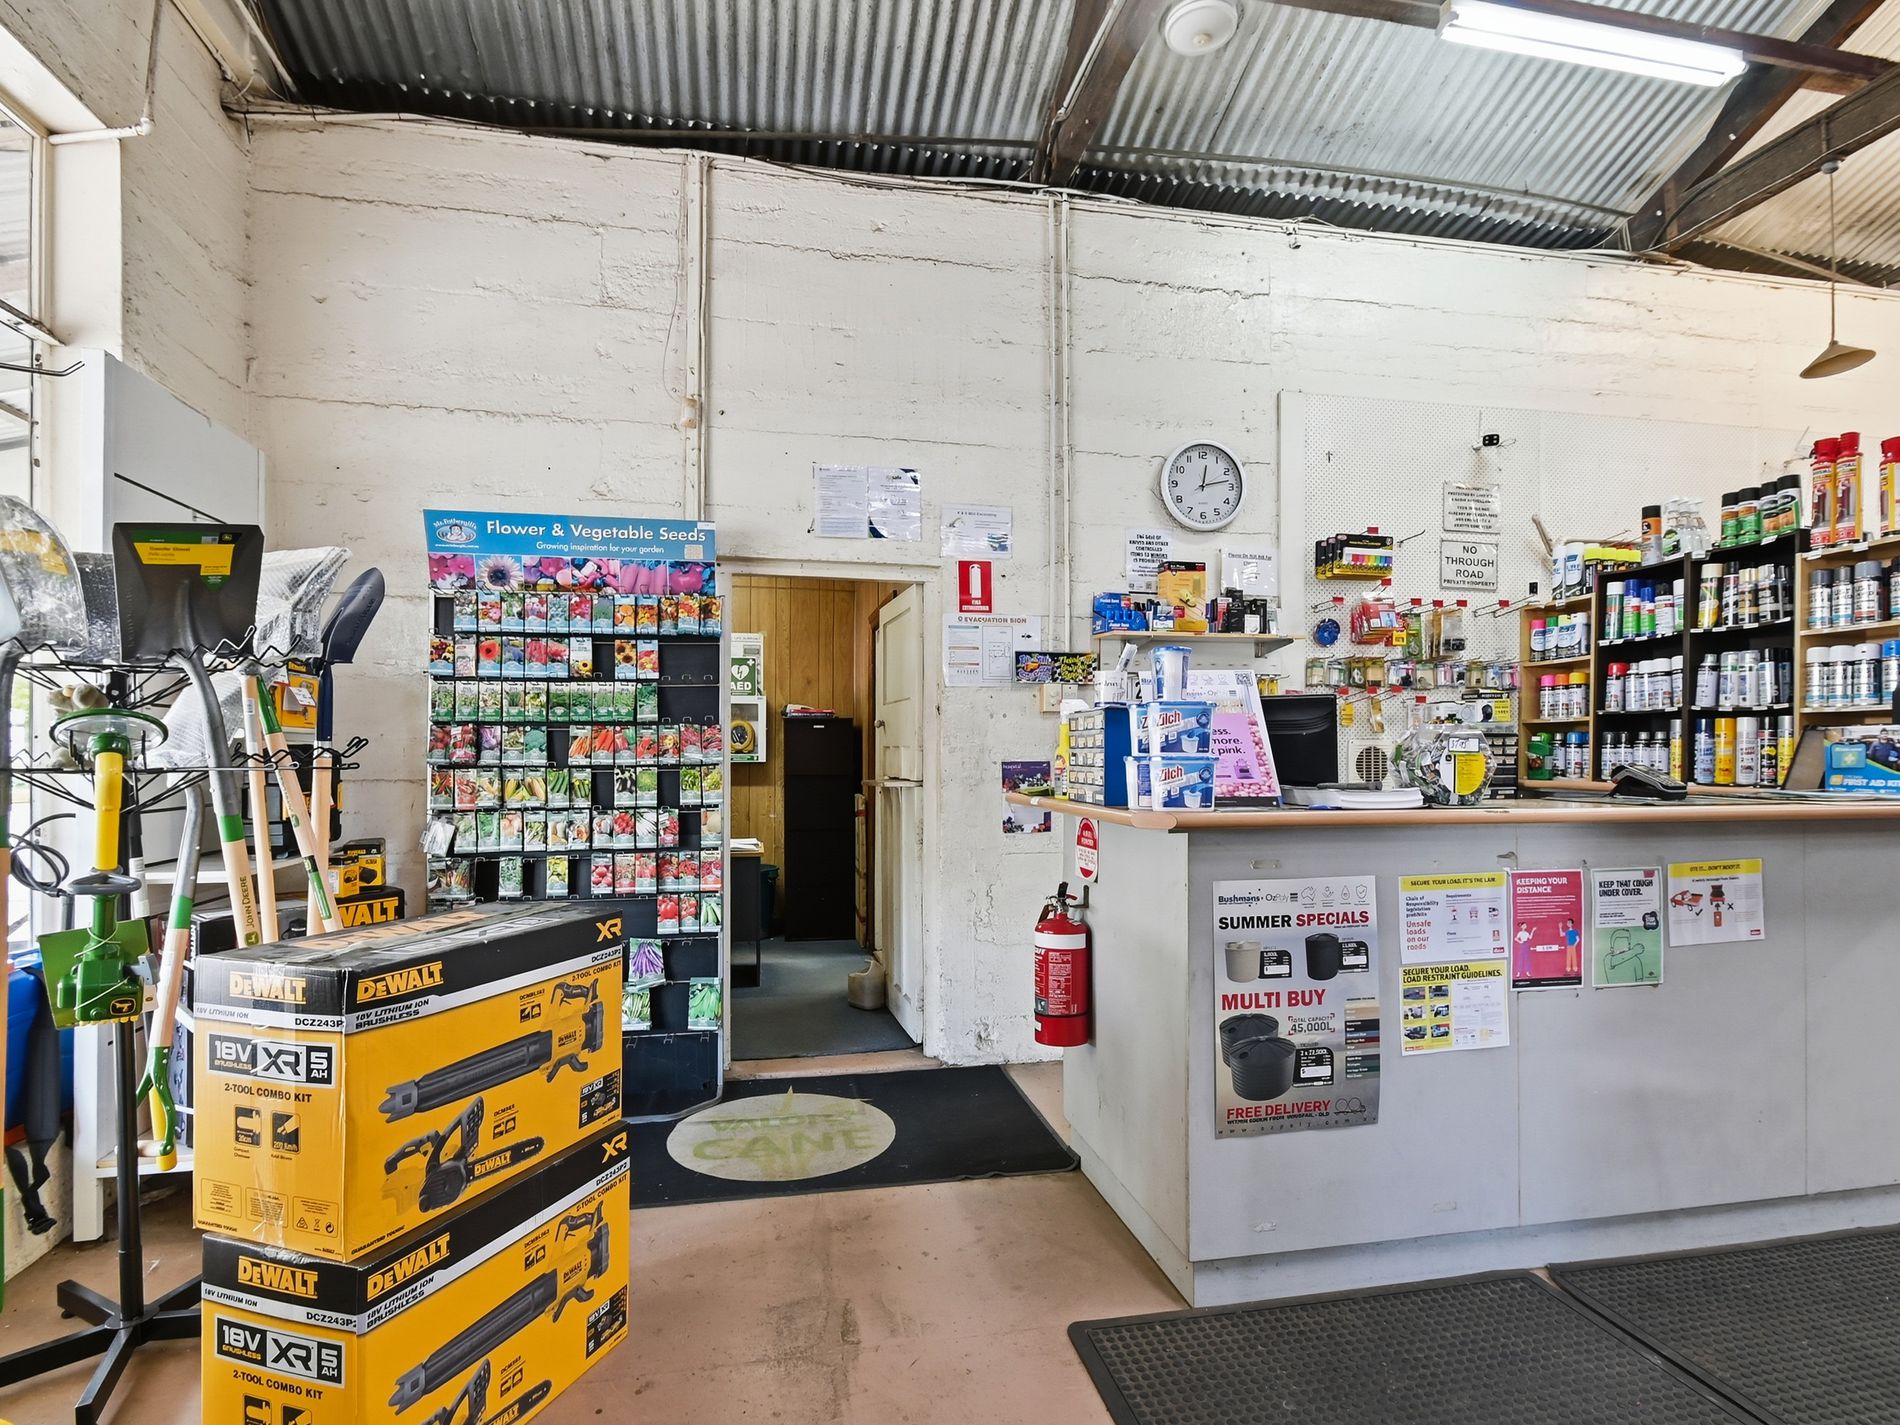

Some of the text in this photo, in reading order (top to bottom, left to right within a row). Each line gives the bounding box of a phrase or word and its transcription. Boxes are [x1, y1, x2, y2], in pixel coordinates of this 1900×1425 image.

[1186, 455, 1192, 463] 11
[1198, 451, 1208, 460] 12
[1215, 456, 1219, 464] 1
[1175, 465, 1185, 474] 10
[1223, 468, 1230, 476] 2
[1171, 480, 1178, 488] 9
[1228, 483, 1235, 491] 3
[1176, 495, 1183, 503] 8
[1223, 497, 1230, 505] 4
[1187, 506, 1194, 514] 7
[1200, 511, 1207, 520] 6
[1213, 508, 1221, 516] 5
[486, 520, 706, 542] Flower & Vegetable Seeds
[536, 541, 664, 555] Growing inspiration for your garden
[1462, 545, 1477, 555] NO
[1444, 556, 1494, 568] THROUGH
[1455, 569, 1484, 579] ROAD
[731, 681, 752, 691] AED
[1157, 709, 1181, 728] Zilch
[1218, 746, 1246, 756] pink.
[1159, 764, 1183, 782] Zilch
[1516, 876, 1567, 886] KEEPING YOUR
[1598, 878, 1653, 889] KEEP THAT COUGH
[1517, 885, 1552, 894] DISTANCE
[1598, 887, 1643, 897] UNDER COVER.
[242, 876, 256, 929] JOHN DEERE
[1218, 894, 1260, 904] Bushmans
[1218, 914, 1292, 931] SUMMER
[1295, 910, 1371, 928] SPECIALS
[1406, 920, 1432, 928] Unsafe
[596, 918, 623, 942] XR
[1406, 928, 1426, 936] loads
[1407, 943, 1427, 951] roads
[1402, 964, 1471, 977] SECURE YOUR LOAD.
[1402, 969, 1503, 984] LOAD RESTRAINT GUIDELINES.
[1221, 989, 1327, 1012] MULTI BUY
[375, 1004, 413, 1019] LITHIUM
[414, 998, 430, 1010] ION
[209, 1009, 236, 1019] LITHIUM
[237, 1012, 250, 1020] ION
[355, 1008, 421, 1031] BRUSHLESS
[295, 1018, 345, 1029] DCZ243P
[1291, 1022, 1332, 1034] 45,000L
[215, 1040, 328, 1077] 18V XR 5
[310, 1069, 328, 1080] AH
[224, 1082, 314, 1104] 2-TOOL COMBO KIT
[1226, 1099, 1332, 1121] FREE DELIVERY
[602, 1132, 628, 1164] XR
[693, 1126, 876, 1161] CANE
[385, 1285, 418, 1311] LITHIUM
[419, 1274, 435, 1292] ION
[216, 1291, 244, 1304] LITHIUM
[245, 1297, 258, 1307] ION
[366, 1291, 425, 1329] BRUSHLESS
[222, 1327, 338, 1373] 18V XR 5
[320, 1366, 338, 1380] AH
[232, 1368, 323, 1402] 2-TOOL COMBO KIT
